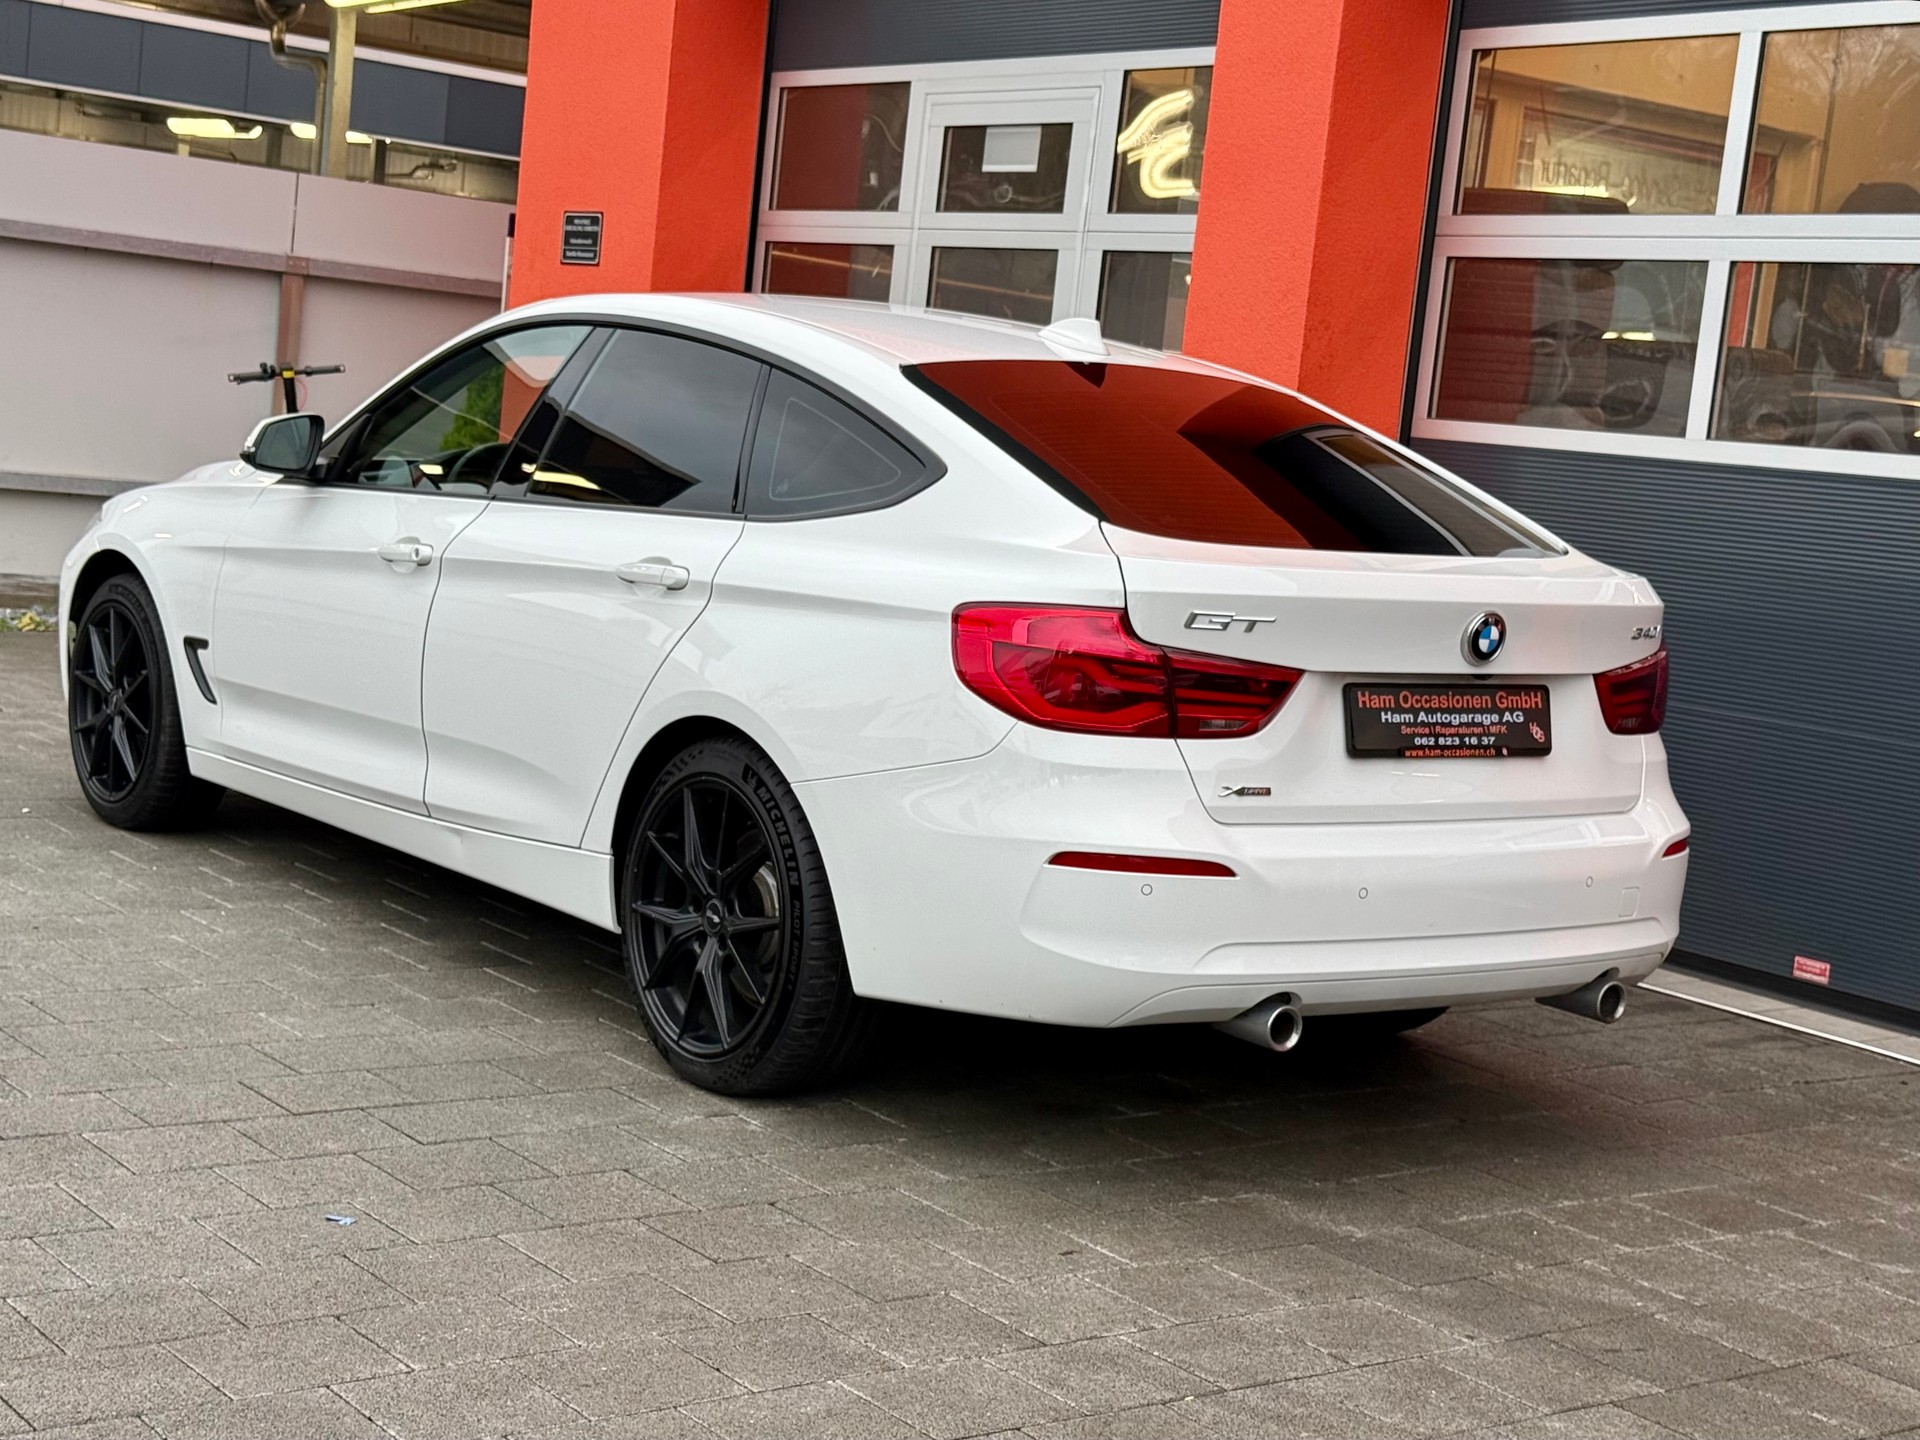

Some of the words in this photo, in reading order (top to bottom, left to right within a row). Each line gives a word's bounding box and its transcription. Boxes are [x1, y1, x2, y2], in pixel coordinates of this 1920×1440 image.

[1183, 610, 1277, 633] GT
[1357, 691, 1395, 708] Ham
[1399, 690, 1491, 709] Occasionen
[1495, 691, 1542, 709] GmbH
[1381, 711, 1414, 723] Ham
[1417, 711, 1499, 726] Autogarage
[1502, 711, 1524, 723] AG
[1400, 725, 1430, 735] Service
[1435, 726, 1484, 736] Reparaturen
[1489, 725, 1508, 734] MFK
[1414, 737, 1436, 746] 062
[1438, 737, 1460, 746] 823
[1463, 737, 1478, 746] 16
[1481, 736, 1496, 746] 37
[1404, 747, 1496, 757] www.ham-occasionen.ch
[756, 786, 800, 886] MICHELIN
[792, 900, 801, 937] PILOT
[788, 940, 799, 981] SPORT
